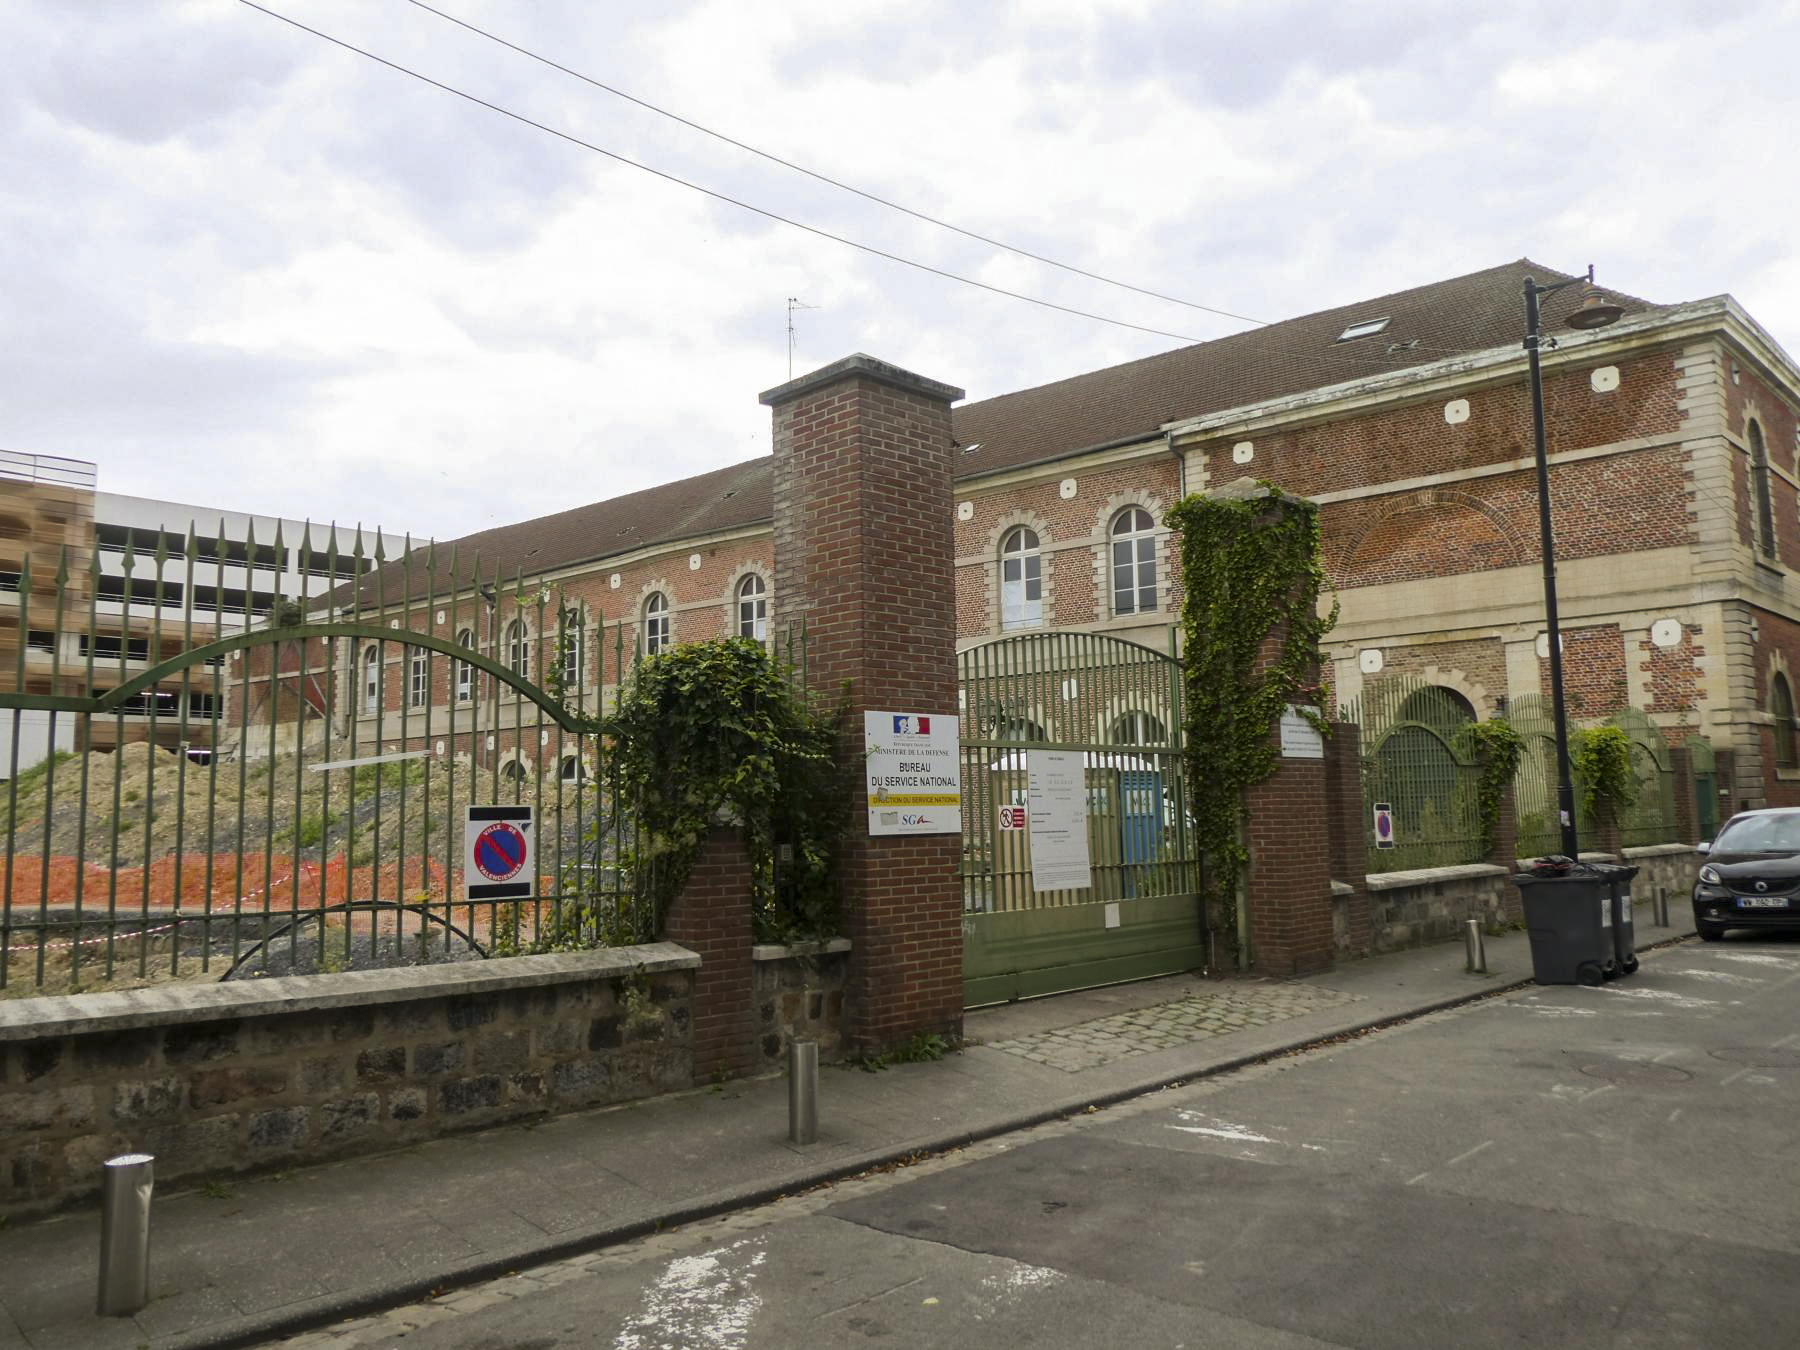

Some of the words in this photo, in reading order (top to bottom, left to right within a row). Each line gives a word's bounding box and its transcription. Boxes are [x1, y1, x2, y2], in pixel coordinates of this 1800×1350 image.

[899, 762, 931, 772] BUREAU
[871, 776, 883, 786] DU
[885, 776, 918, 786] SERVICE
[920, 776, 956, 787] NATIONAL
[483, 825, 501, 836] VILLE
[508, 826, 517, 835] DE
[479, 863, 522, 881] VALENCIENNES
